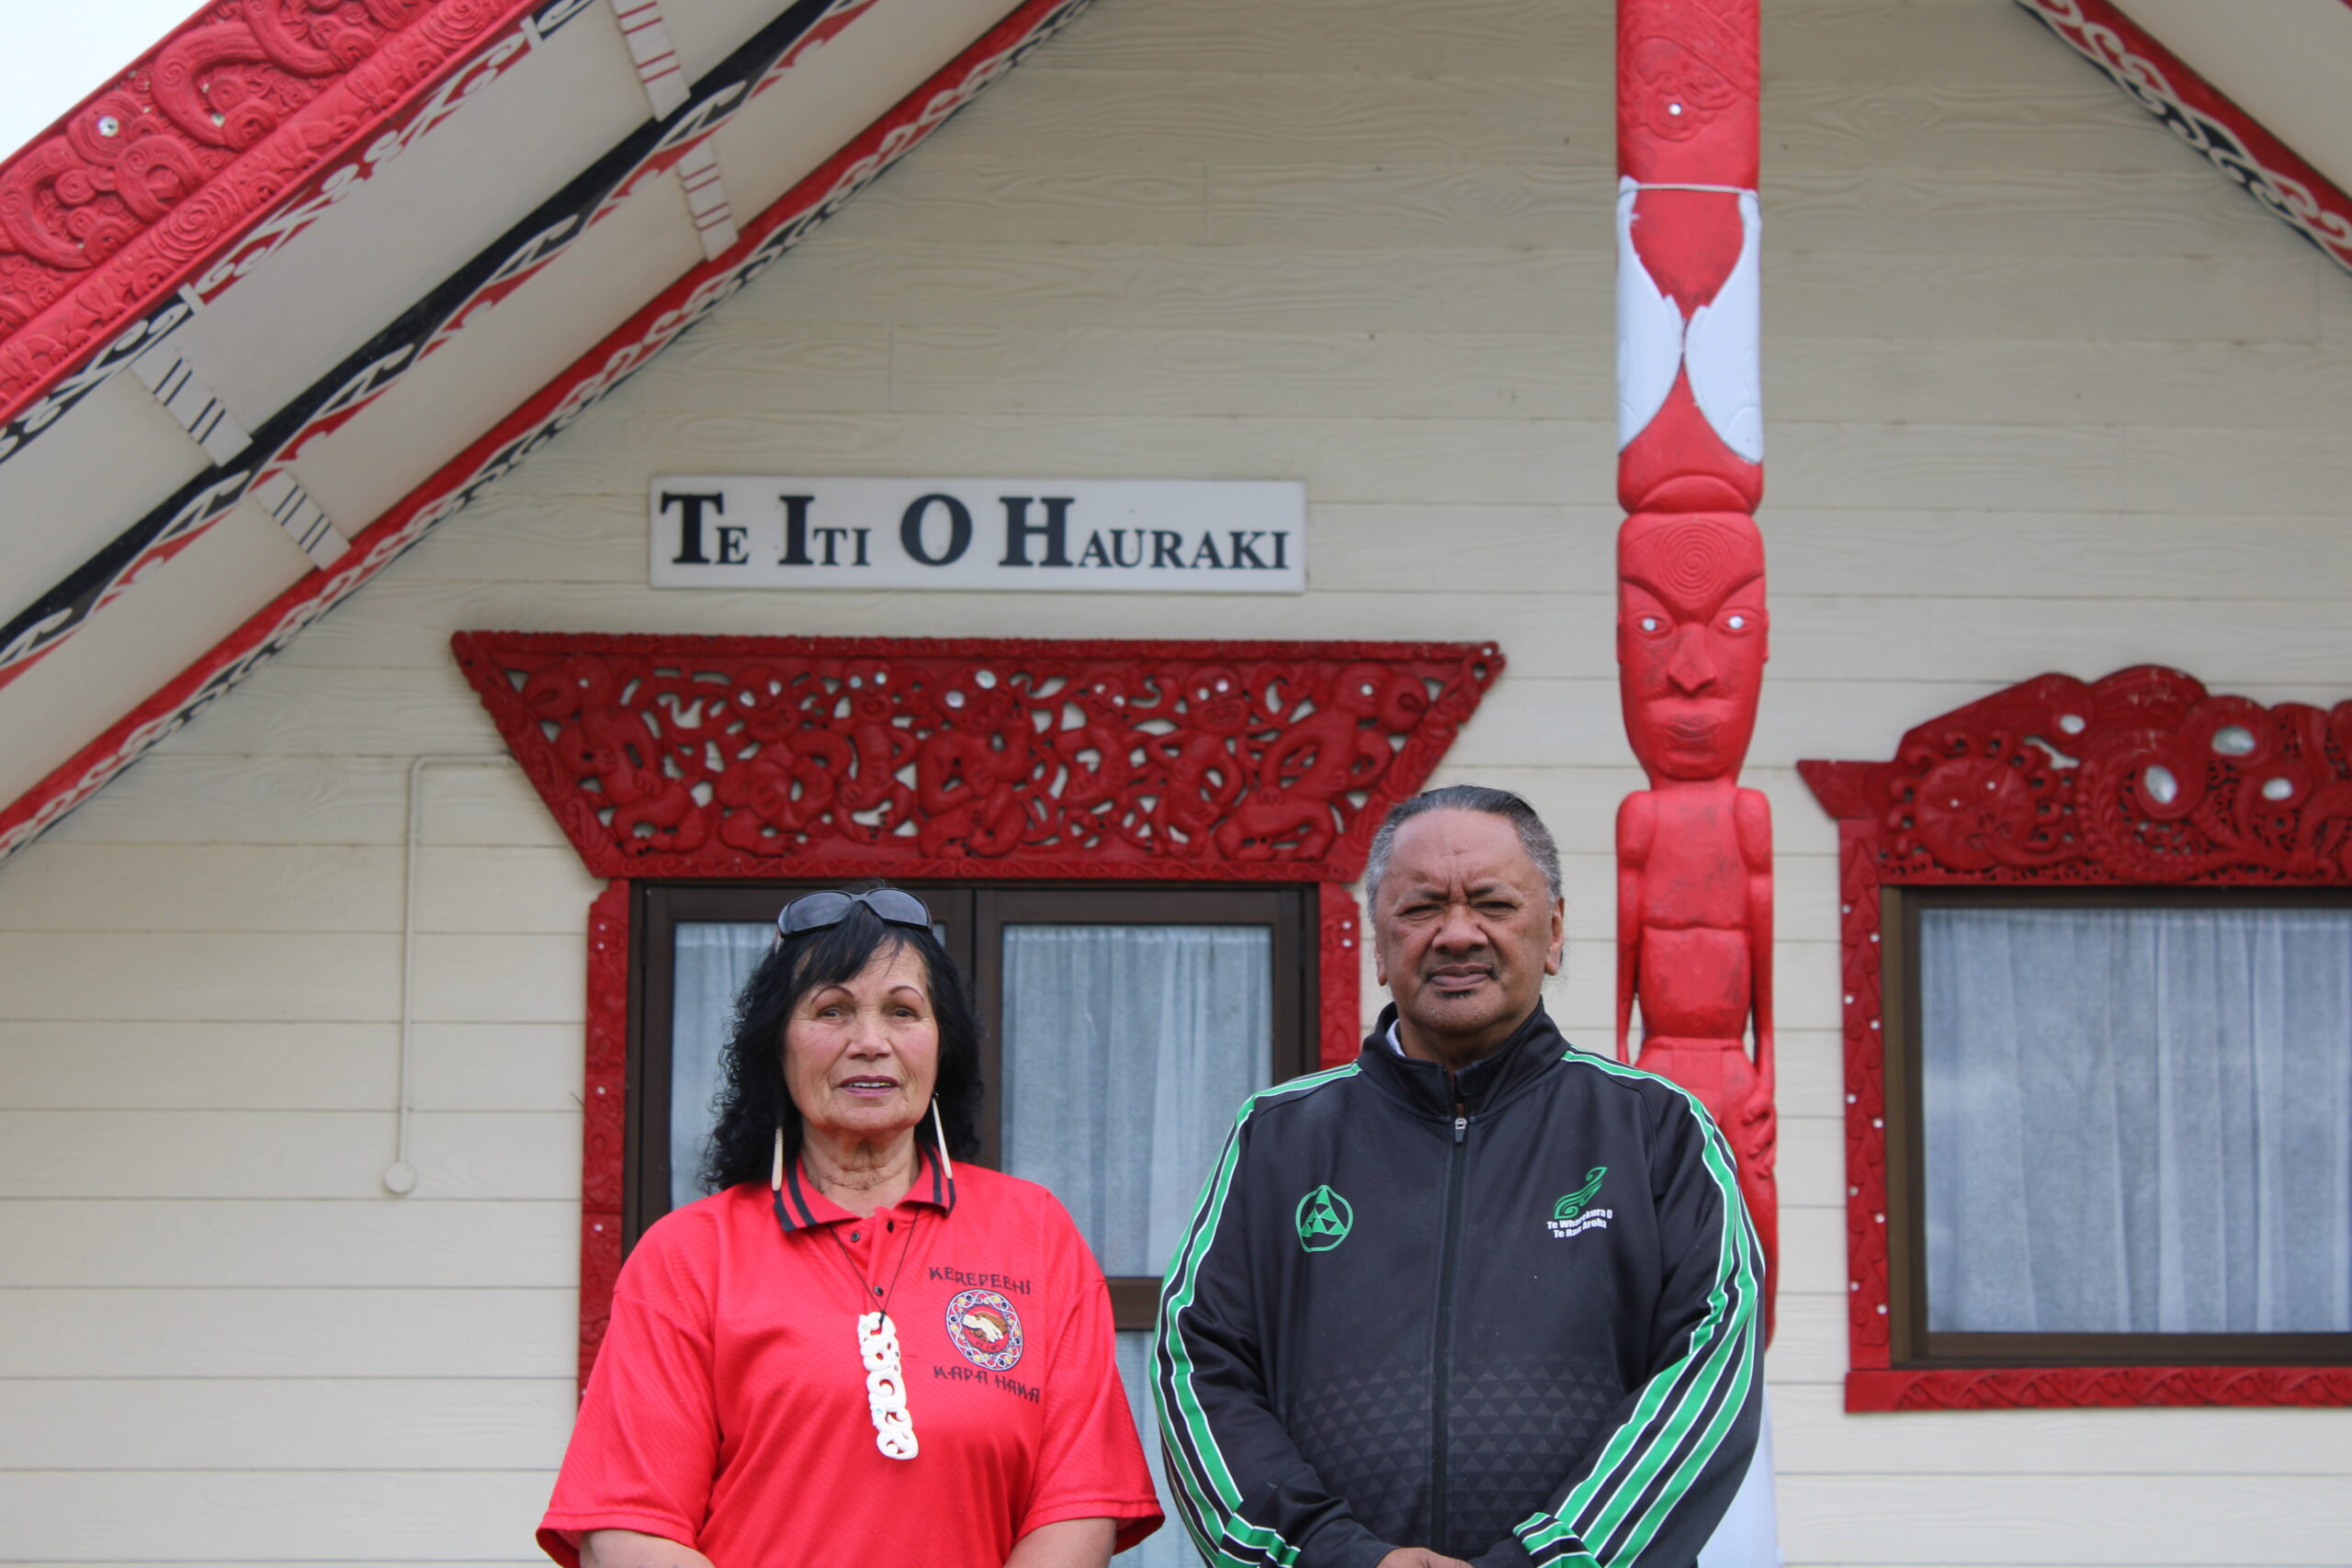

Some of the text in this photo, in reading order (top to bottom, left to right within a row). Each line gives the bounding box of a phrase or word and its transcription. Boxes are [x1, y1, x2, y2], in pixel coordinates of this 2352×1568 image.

[899, 492, 974, 568] O
[1546, 1221, 1558, 1229] Te
[1554, 1229, 1565, 1238] Te
[1582, 1218, 1607, 1230] Aroha
[929, 1267, 1031, 1295] KEREPEEHI
[933, 1365, 1040, 1404] KAPA HAKA
